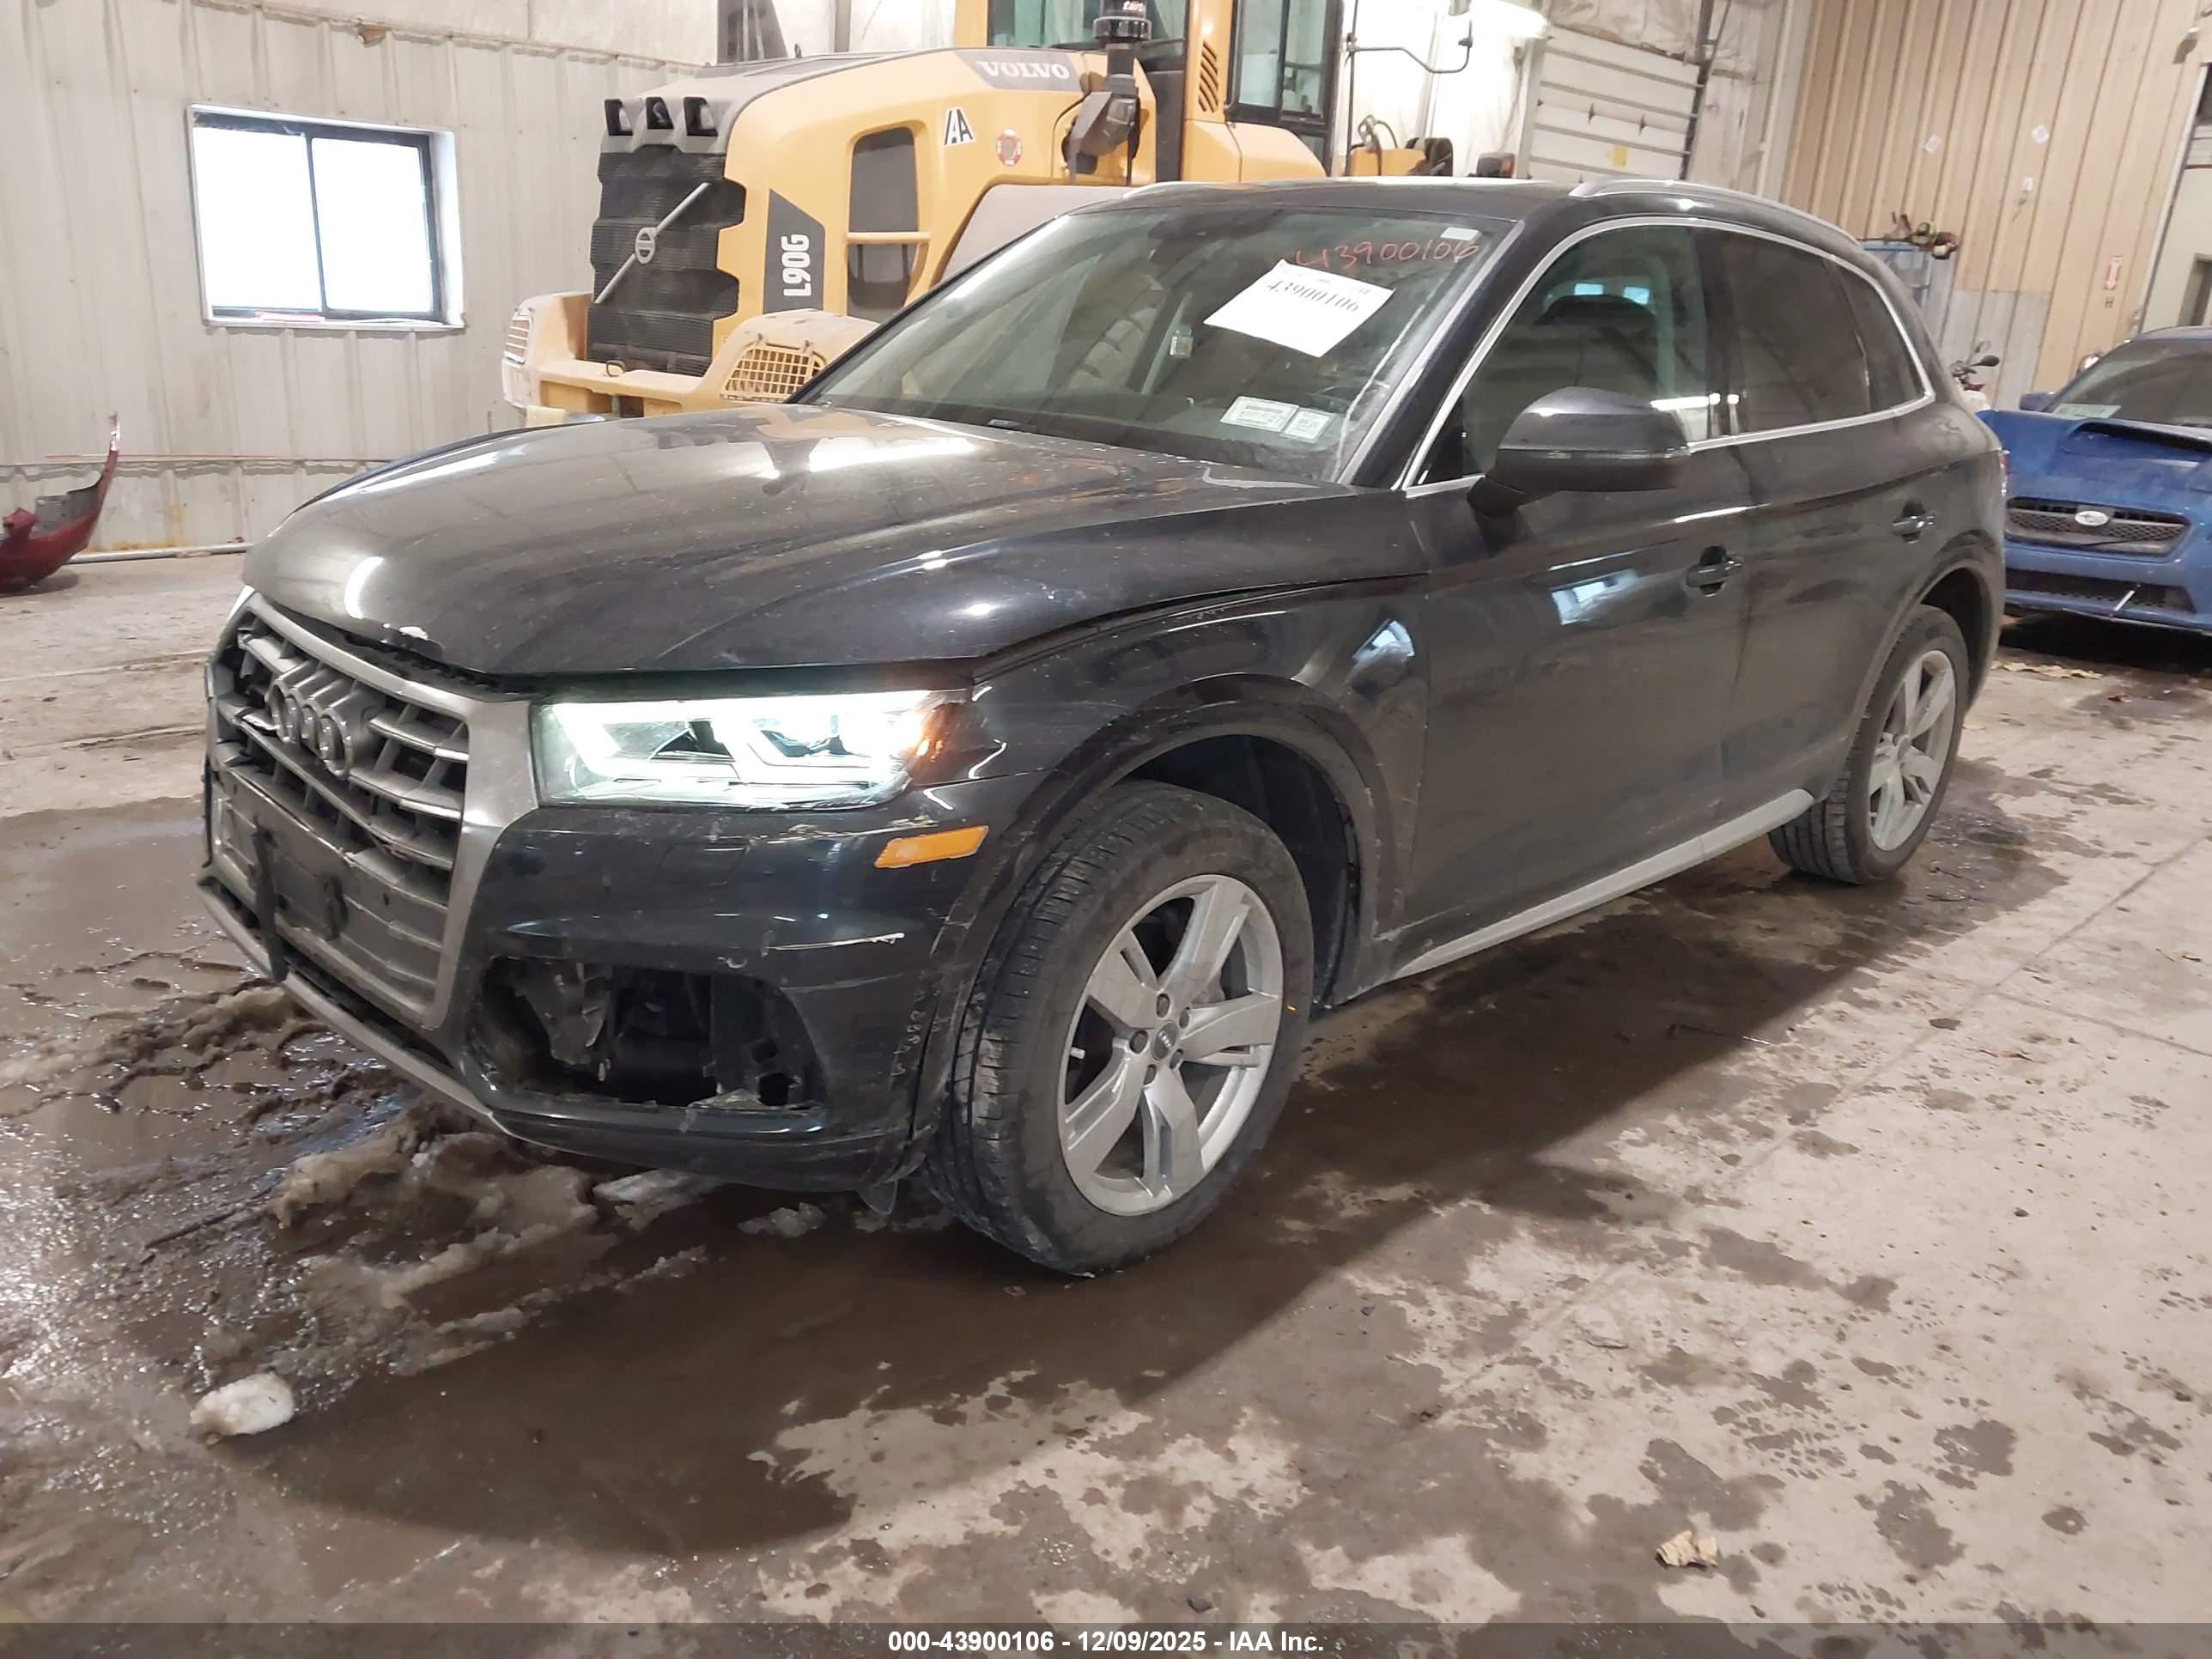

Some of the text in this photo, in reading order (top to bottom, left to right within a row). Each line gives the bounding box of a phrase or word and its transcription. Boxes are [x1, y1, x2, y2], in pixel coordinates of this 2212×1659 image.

[976, 61, 1070, 80] VOLVO
[781, 234, 812, 296] L90G
[1294, 239, 1480, 270] 43900106
[1267, 280, 1359, 313] 43900106
